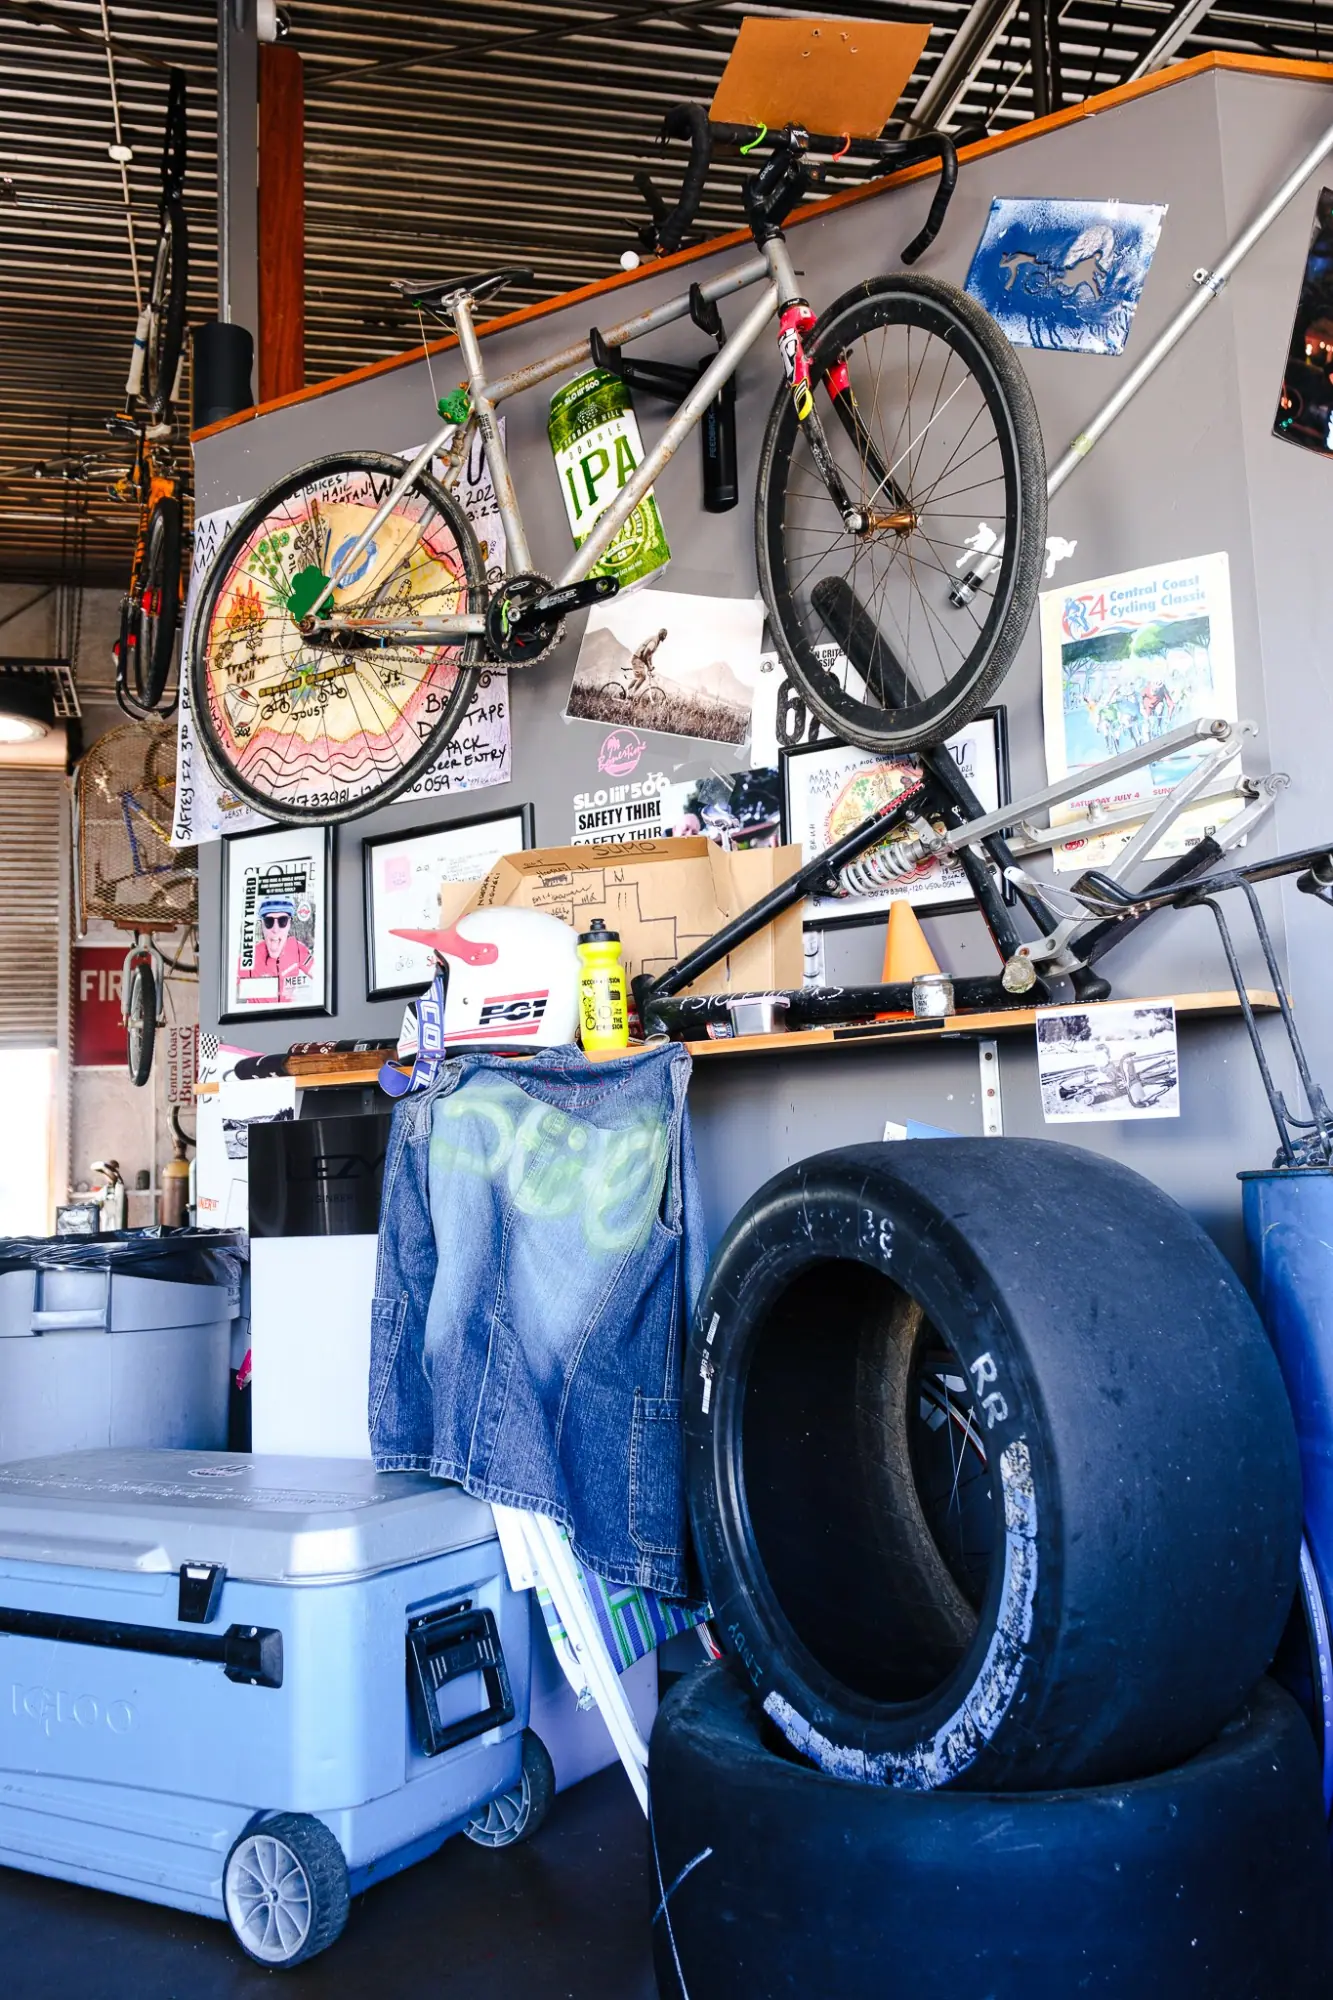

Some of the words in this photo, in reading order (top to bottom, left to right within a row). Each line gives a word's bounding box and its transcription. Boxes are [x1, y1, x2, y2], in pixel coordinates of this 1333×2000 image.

[565, 434, 638, 520] IPA
[1110, 581, 1158, 602] Central
[1162, 574, 1201, 593] Coast
[1109, 599, 1156, 618] Cycling
[1161, 589, 1206, 607] Classic
[290, 703, 328, 721] JOUST
[465, 703, 505, 726] TAPE
[465, 744, 507, 768] ENTRY
[573, 790, 608, 811] SLO
[578, 807, 622, 831] SAFETY
[592, 842, 656, 856] SUMO
[244, 877, 257, 917] THIRD
[242, 921, 255, 967] SAFETY
[79, 969, 128, 1002] FIR
[285, 976, 308, 986] MEET
[167, 1027, 178, 1059] Coast
[179, 1025, 194, 1105] BREWING
[167, 1063, 178, 1103] Central
[970, 1352, 1008, 1430] RR
